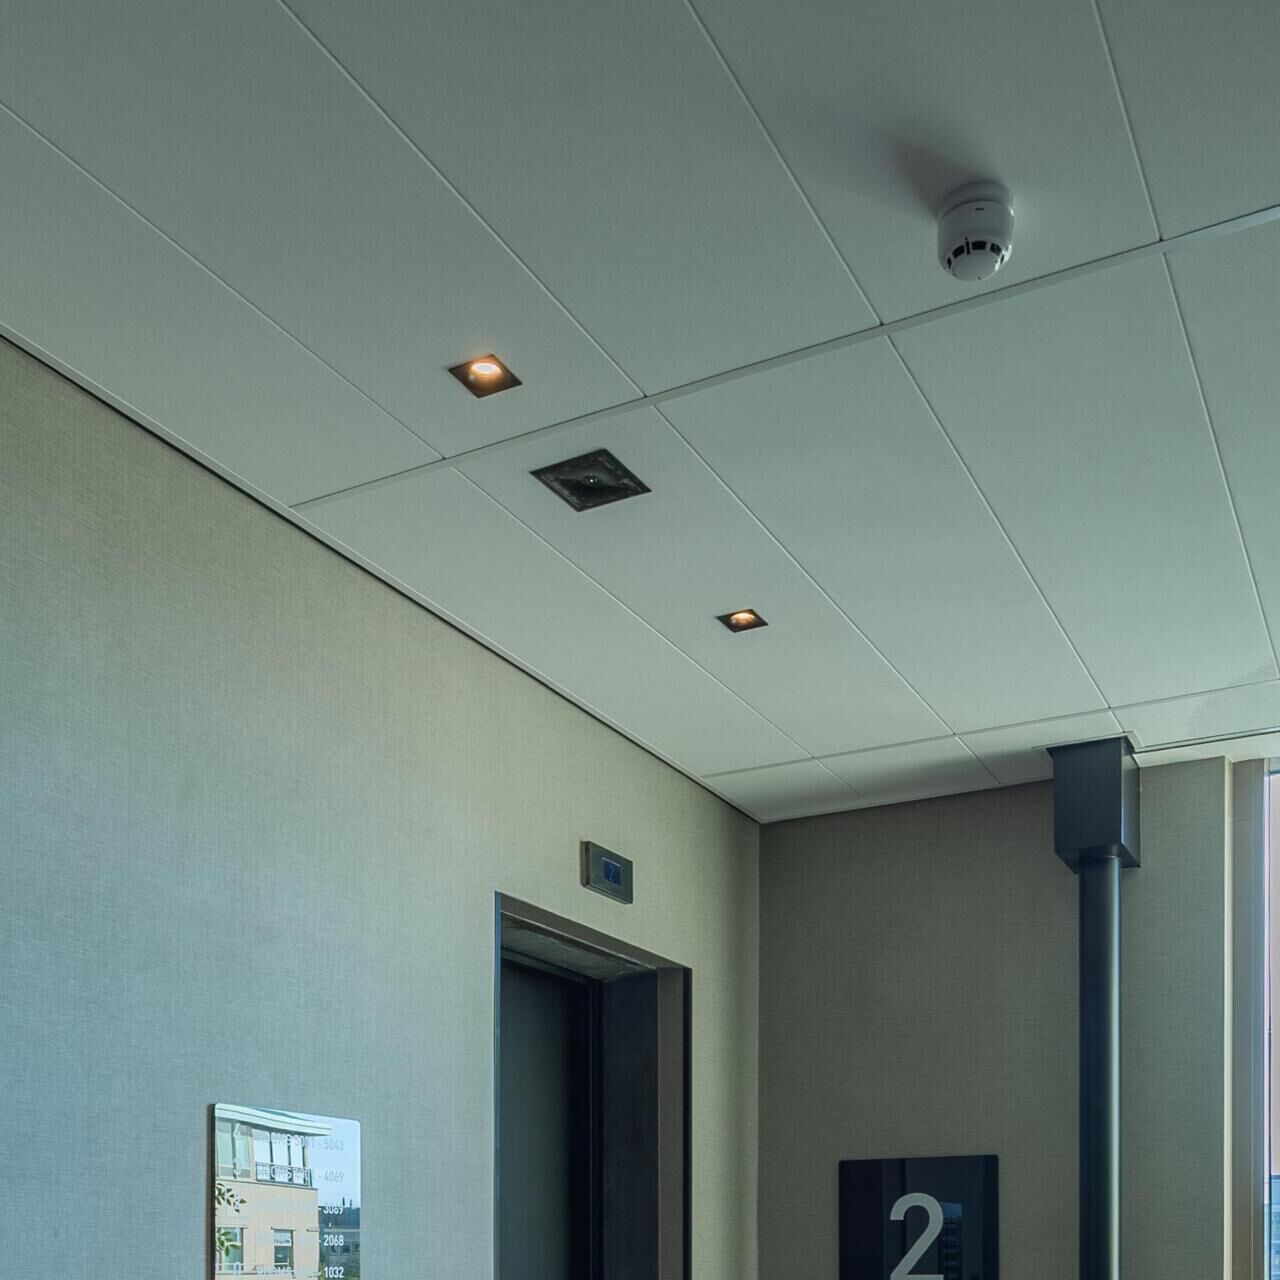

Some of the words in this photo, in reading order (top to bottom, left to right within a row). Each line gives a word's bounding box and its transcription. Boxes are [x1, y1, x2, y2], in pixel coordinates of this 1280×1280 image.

[324, 1138, 345, 1151] 5043
[323, 1169, 345, 1183] 4069
[323, 1234, 345, 1246] 2068
[324, 1266, 345, 1279] 1032
